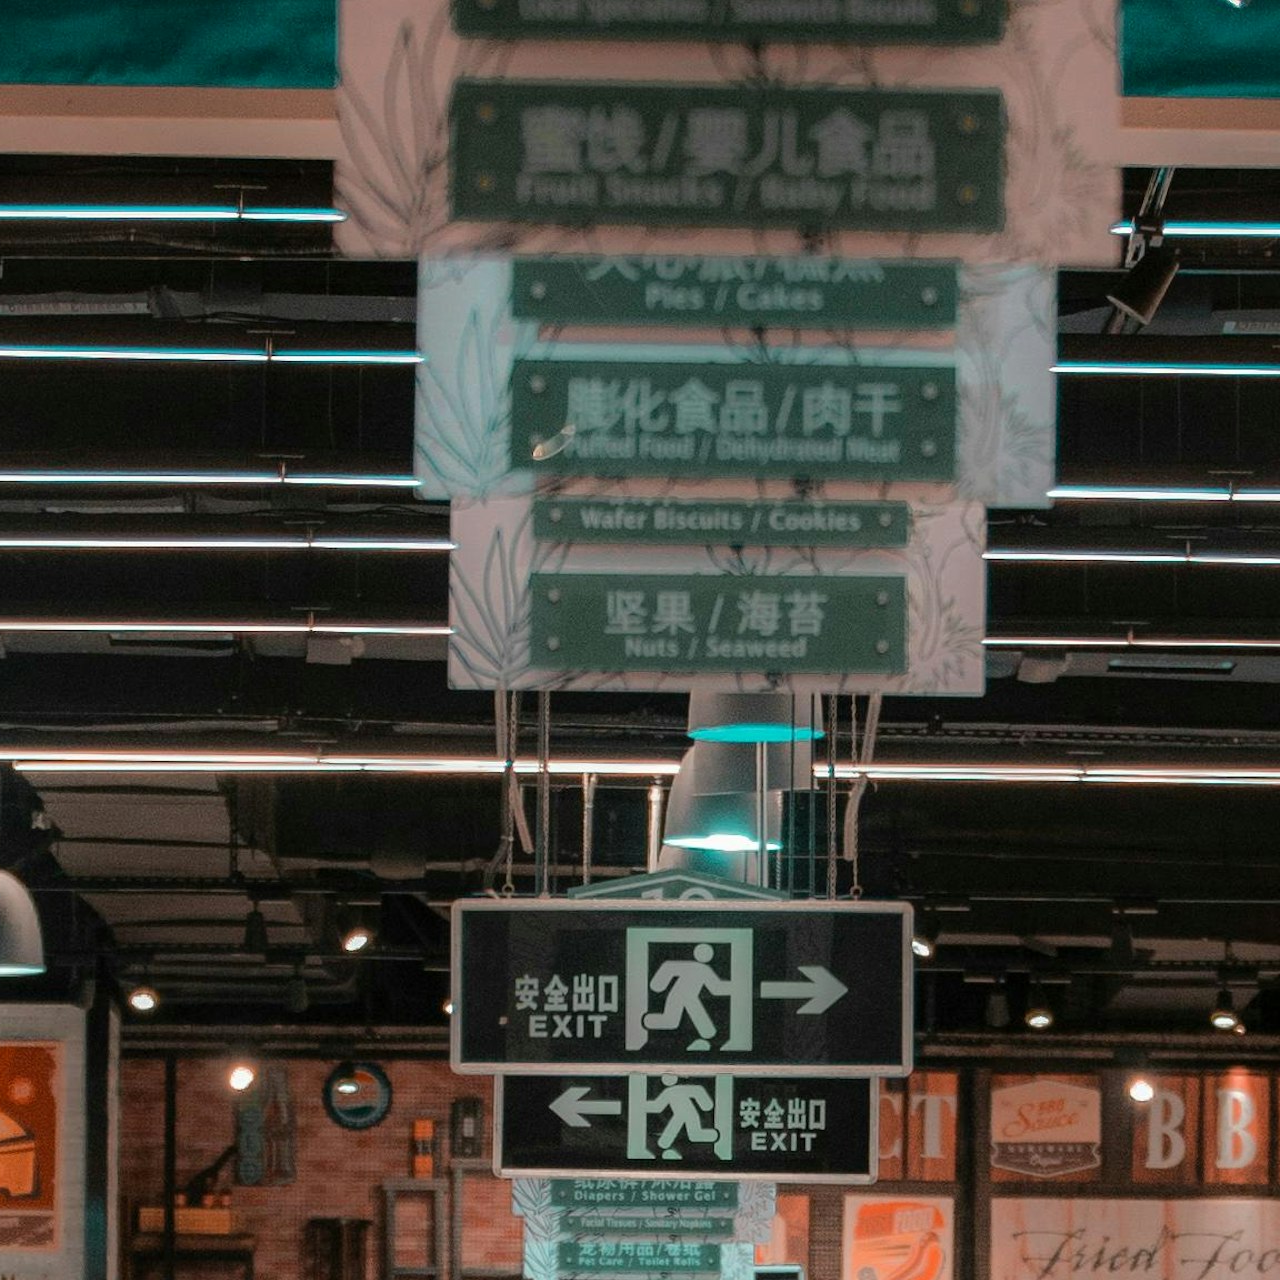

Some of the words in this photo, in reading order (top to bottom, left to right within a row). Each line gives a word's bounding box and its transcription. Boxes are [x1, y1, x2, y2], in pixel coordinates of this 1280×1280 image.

[646, 281, 704, 310] Pies
[736, 283, 821, 311] Cakes
[580, 508, 647, 530] Wafer
[654, 508, 742, 530] Biscuits
[770, 509, 862, 532] Cookies
[625, 638, 680, 659] Nuts
[706, 638, 807, 660] Seaweed
[515, 973, 618, 1012] 安全出口
[529, 1015, 607, 1038] EXIT
[740, 1098, 826, 1131] 安全出口
[751, 1133, 816, 1152] EXIT
[574, 1190, 625, 1202] Diapers
[642, 1190, 690, 1201] Shower
[694, 1190, 716, 1201] Gel
[579, 1257, 596, 1267] Pet
[599, 1257, 624, 1267] Care
